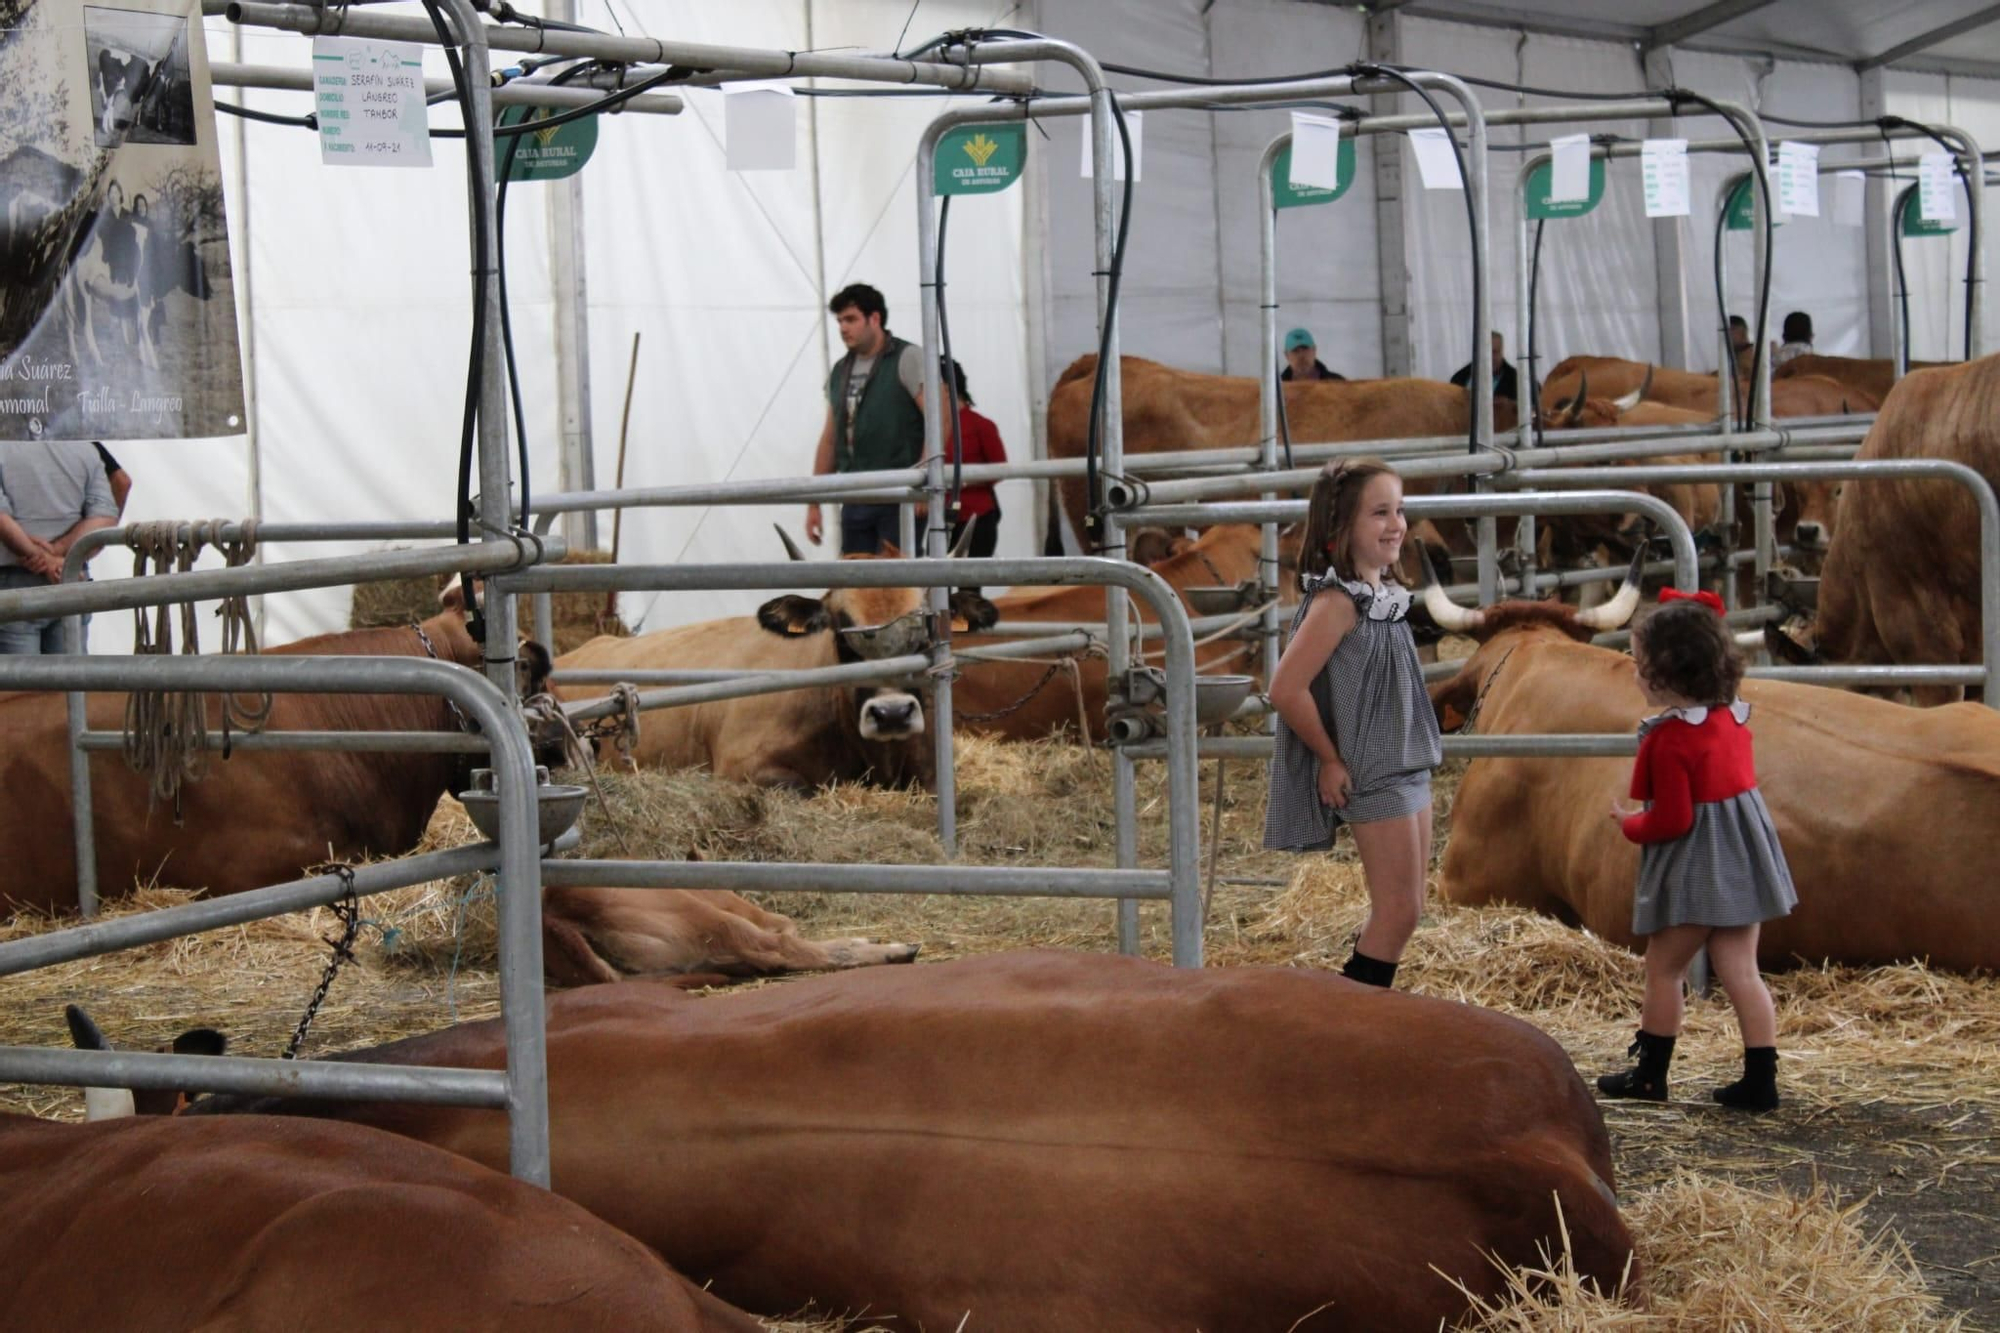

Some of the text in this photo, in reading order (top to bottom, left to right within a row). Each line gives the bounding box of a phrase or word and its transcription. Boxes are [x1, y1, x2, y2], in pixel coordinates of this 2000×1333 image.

[361, 91, 398, 103] LANGREO
[363, 108, 398, 120] TAMBOR
[515, 146, 577, 158] CAJA RURAL
[953, 166, 1009, 178] CAJA RURAL
[18, 355, 72, 380] Suárez
[130, 390, 182, 424] Langreo
